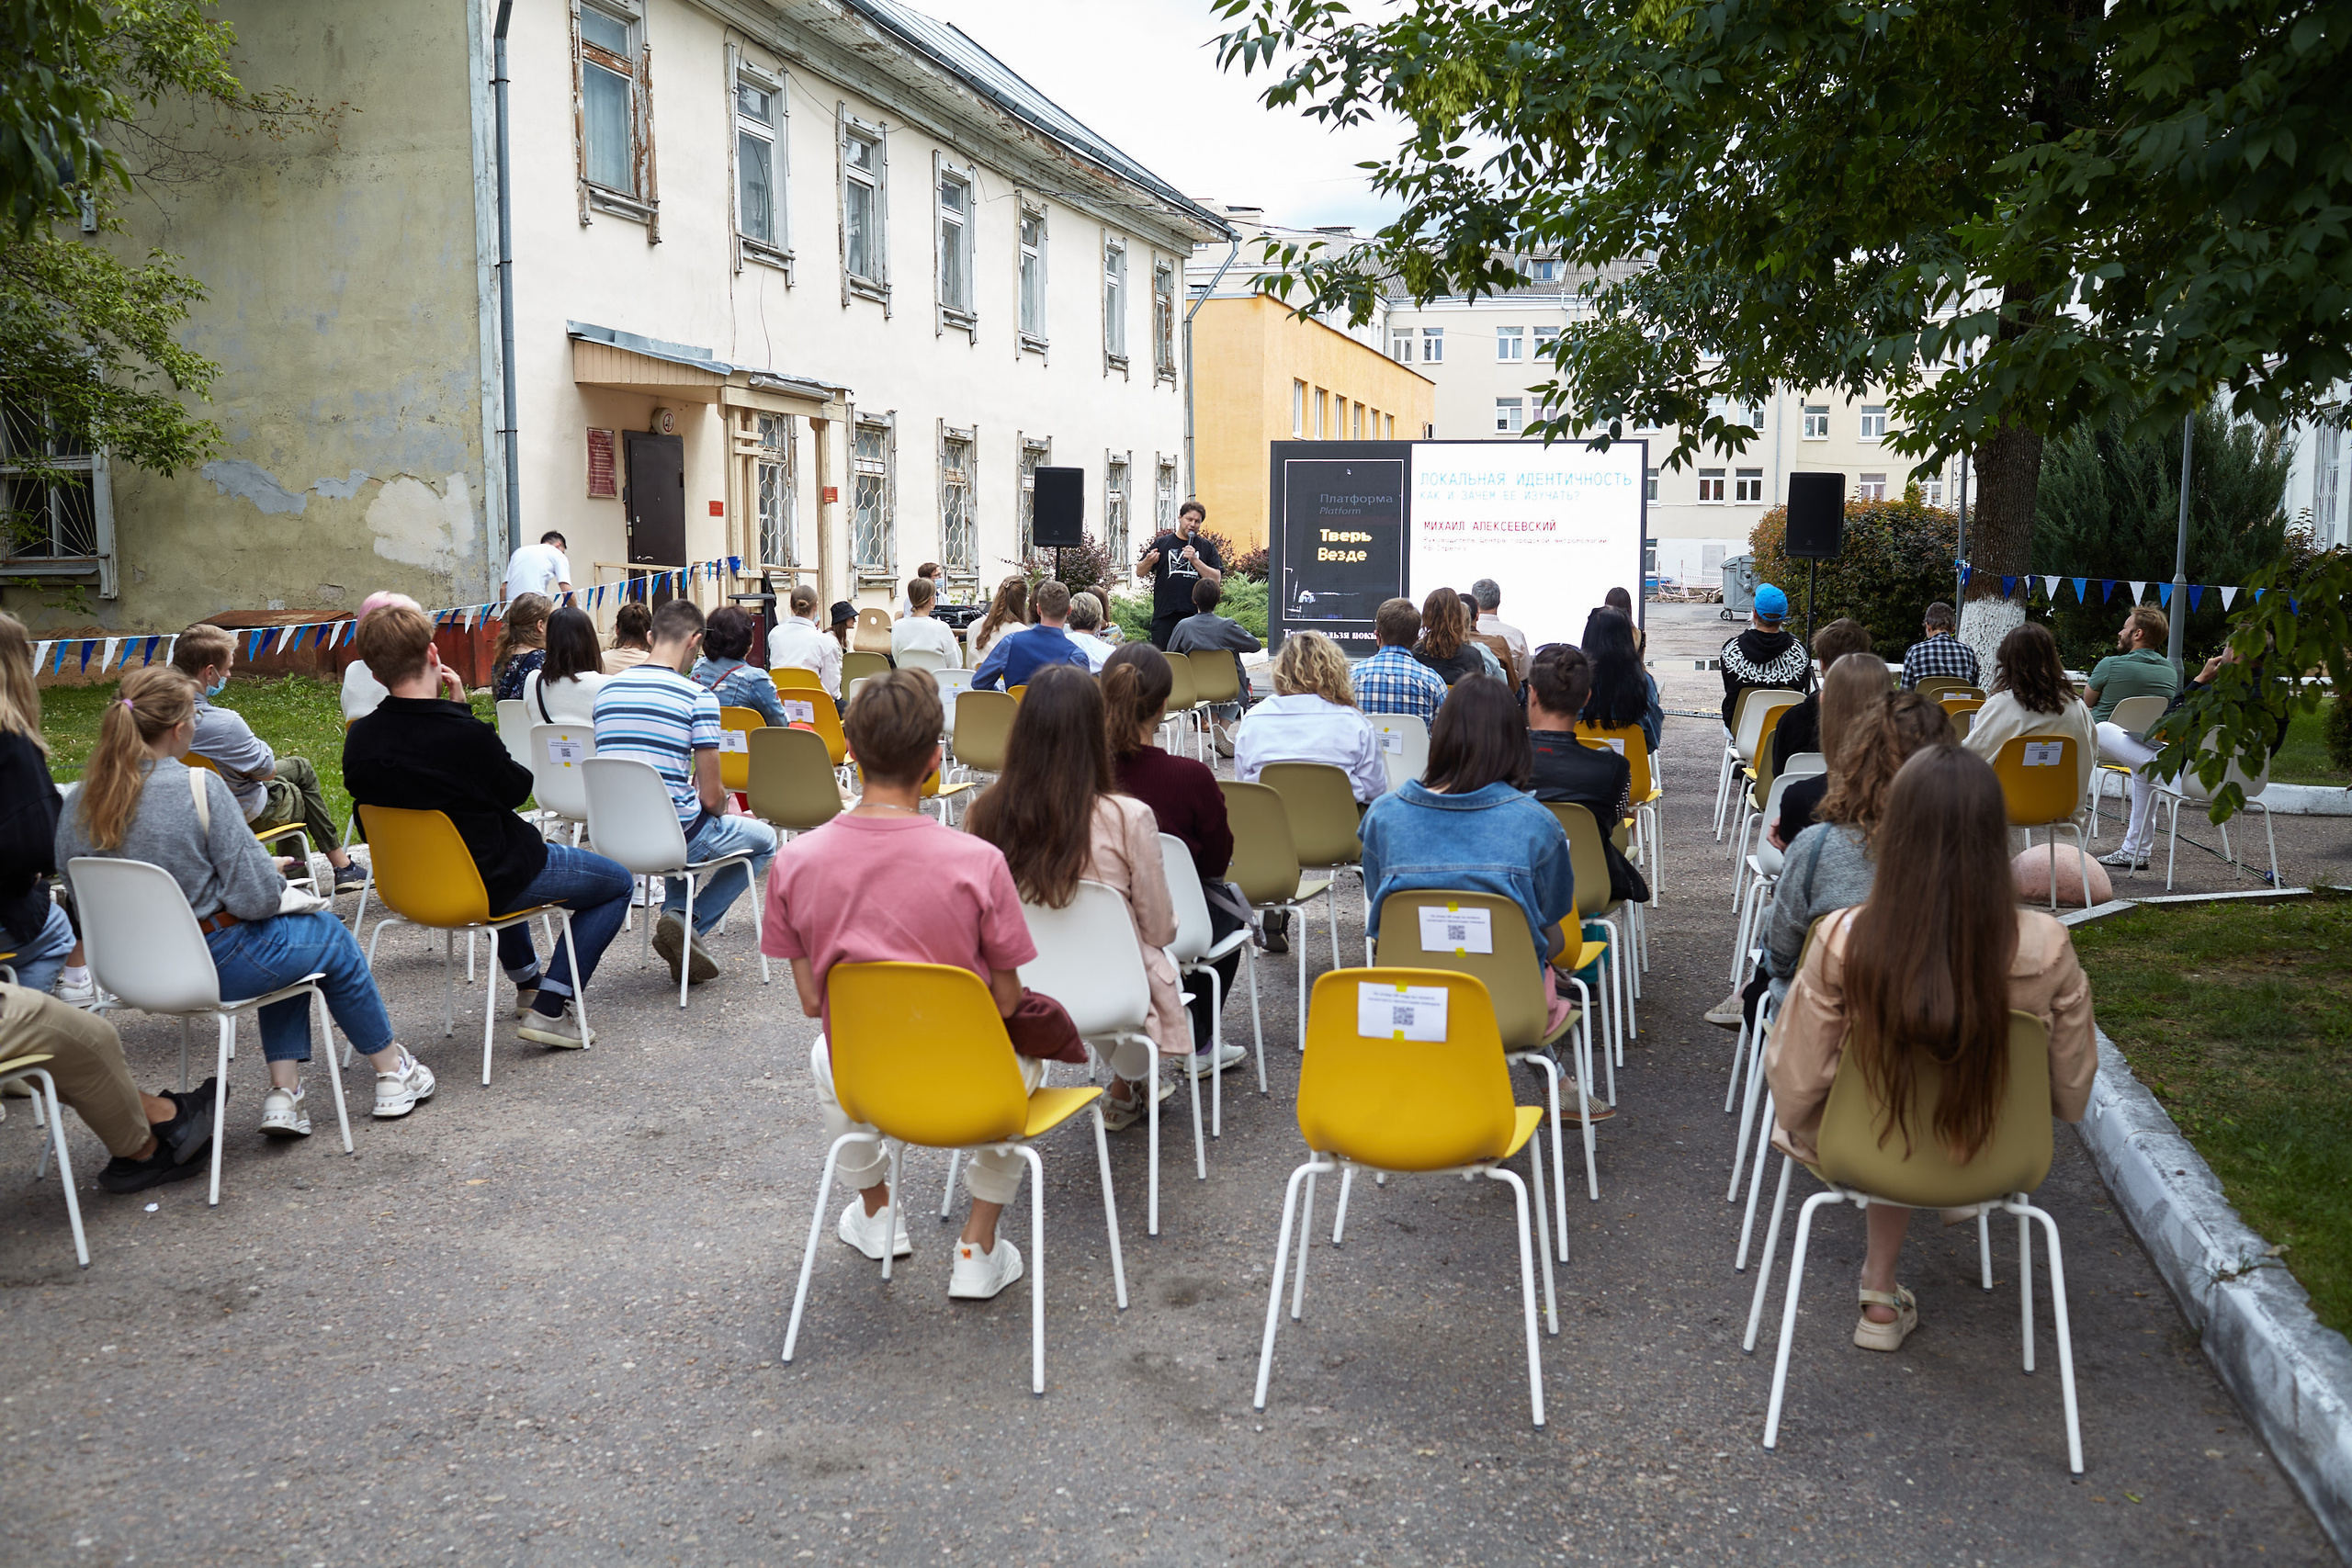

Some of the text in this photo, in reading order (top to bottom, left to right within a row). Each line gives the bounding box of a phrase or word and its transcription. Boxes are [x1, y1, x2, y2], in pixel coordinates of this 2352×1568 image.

[1420, 472, 1633, 487] ЛОКАЛЬНАЯ ИДЕНТИЧНОСТЬ
[1320, 493, 1393, 505] Платформа
[1419, 491, 1580, 501] КАК И ЗАЧЕМ ЕЕ ИЗУЧАТЬ?
[1319, 507, 1362, 515] Platform
[1424, 519, 1556, 531] МИХАИЛ АЛЕКСЕЕВСКИЙ
[1319, 528, 1373, 543] Тверь
[1317, 547, 1367, 562] Везде
